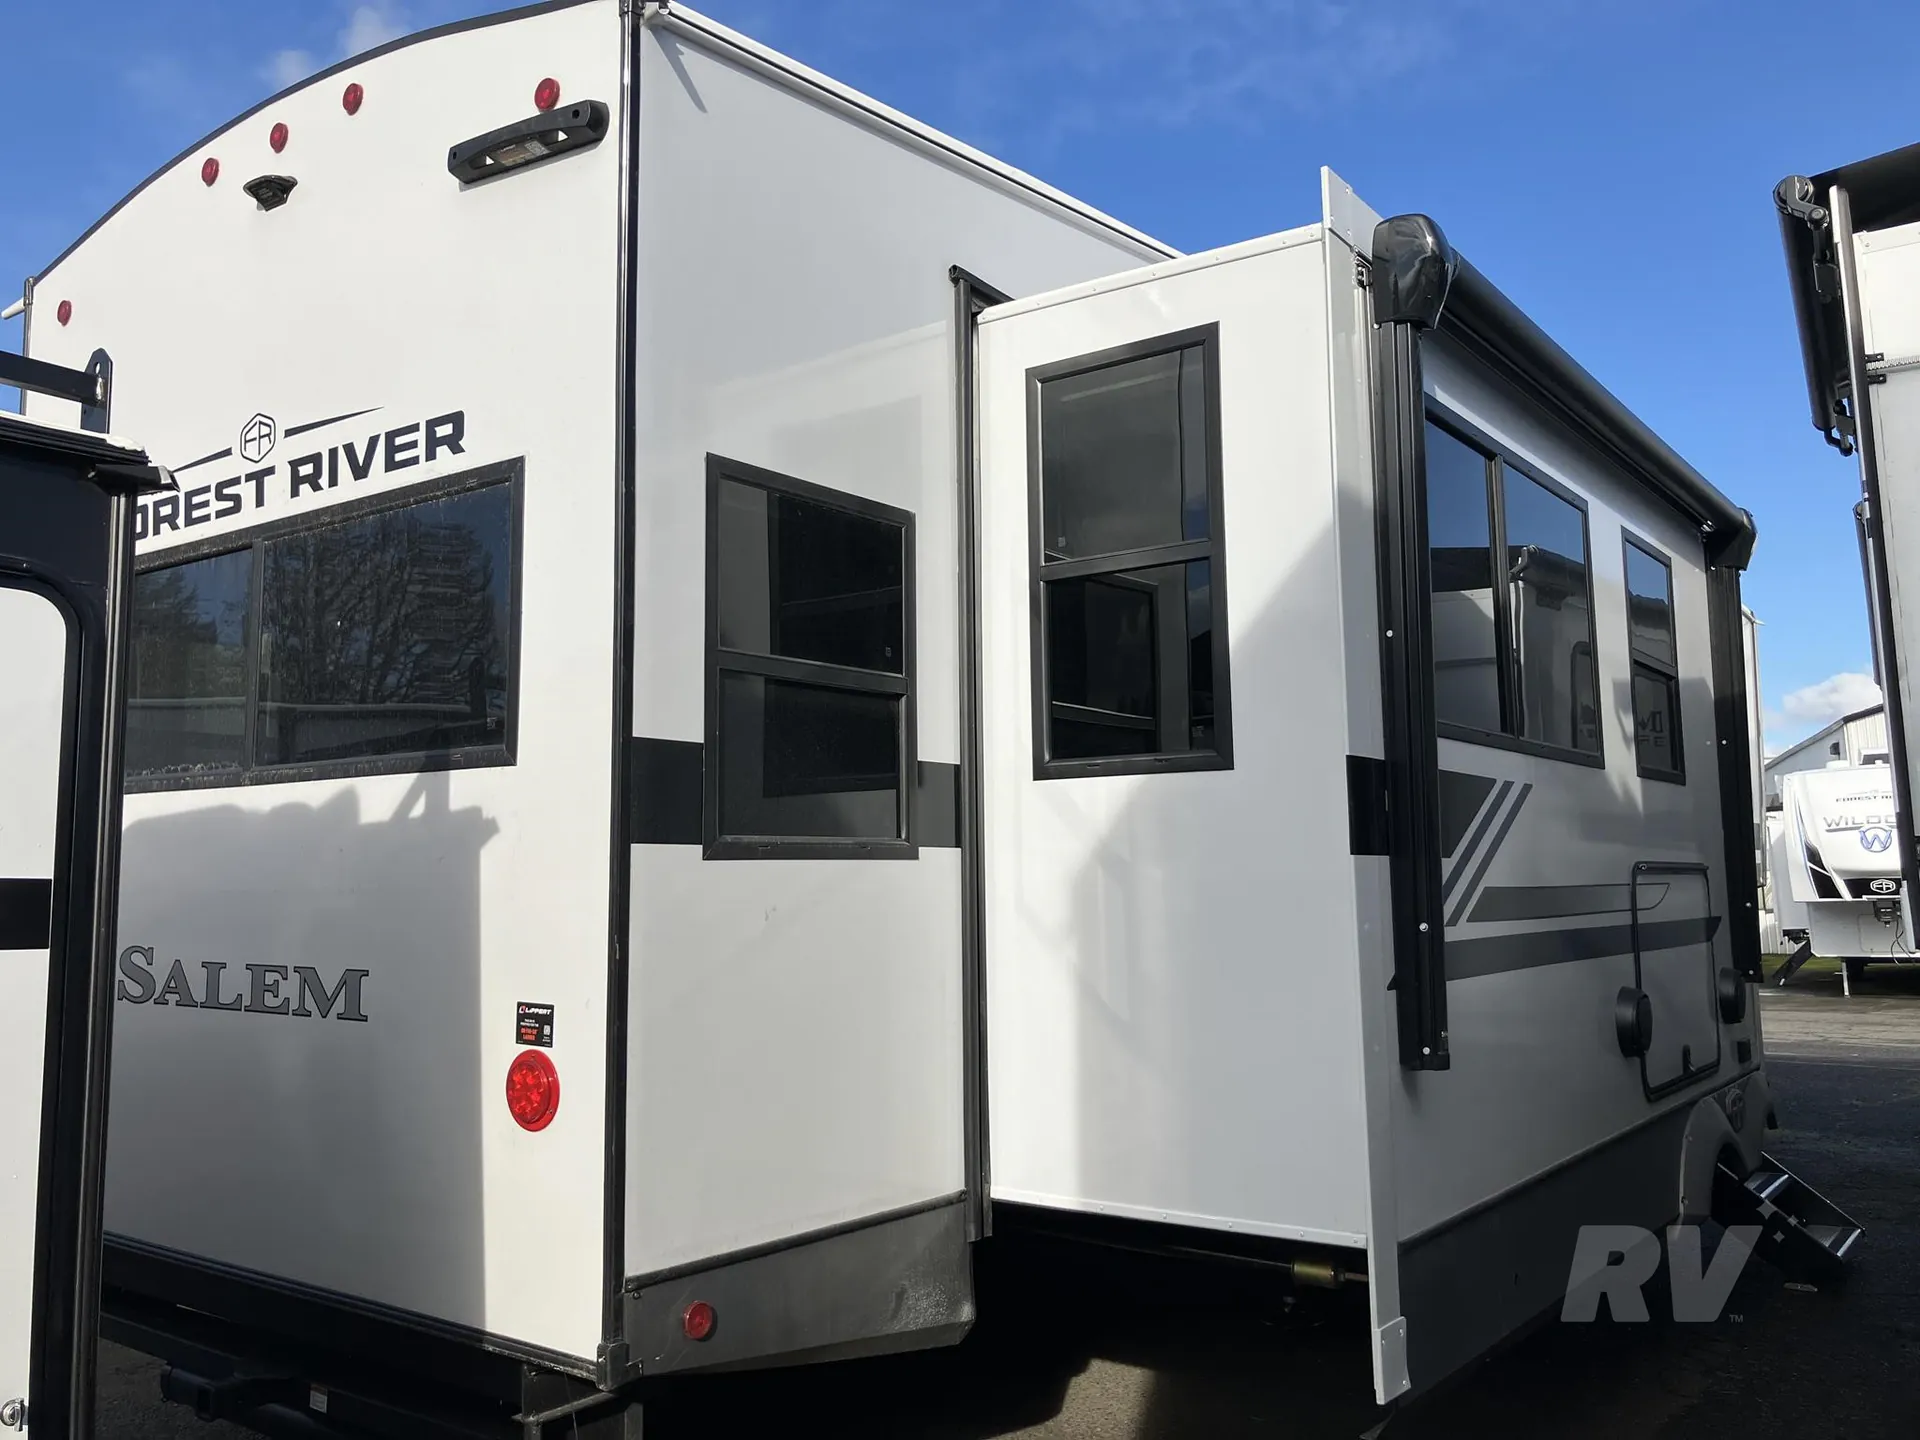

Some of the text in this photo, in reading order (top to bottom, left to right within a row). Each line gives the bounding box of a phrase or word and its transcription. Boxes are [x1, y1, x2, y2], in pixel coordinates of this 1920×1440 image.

[135, 410, 467, 541] OREST RIVER
[1823, 815, 1897, 828] WILDC
[117, 945, 369, 1022] SALEM
